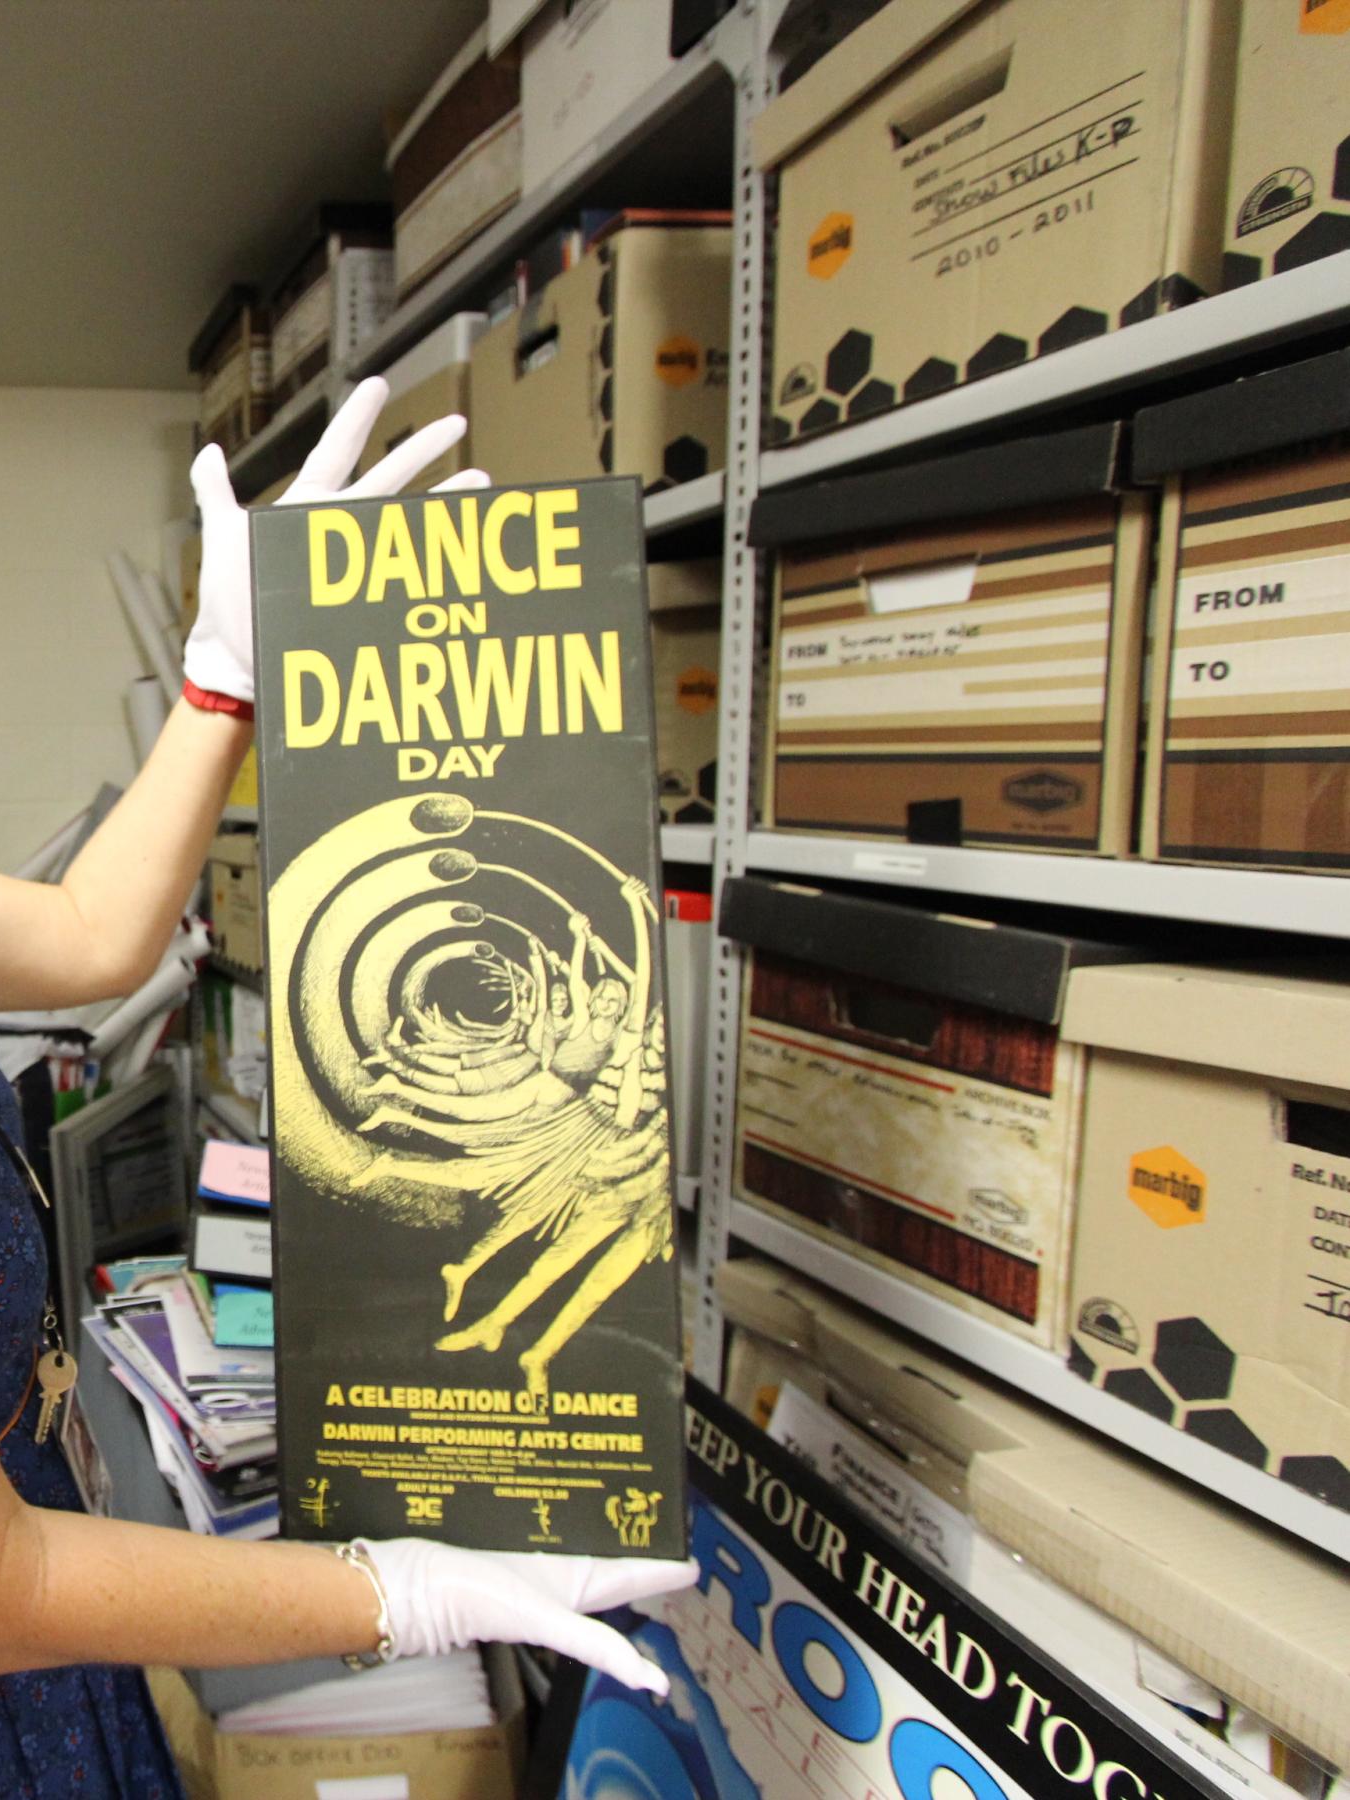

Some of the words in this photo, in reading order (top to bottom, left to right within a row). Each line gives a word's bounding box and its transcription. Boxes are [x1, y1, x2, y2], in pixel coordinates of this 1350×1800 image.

[936, 236, 1000, 278] 2010
[1032, 190, 1095, 232] 2011
[308, 488, 582, 606] DANCE
[1194, 581, 1286, 613] FROM
[405, 601, 486, 638] ON
[787, 643, 828, 660] FROM
[1190, 660, 1229, 684] TO
[283, 630, 623, 749] DARWIN
[786, 692, 806, 707] TO
[397, 744, 506, 782] DAY
[1132, 1166, 1204, 1213] marbig
[1291, 1162, 1327, 1186] Ref.
[325, 1384, 345, 1406] A
[348, 1385, 513, 1412] CELEBRATION
[553, 1392, 638, 1417] DANCE
[322, 1422, 396, 1442] DARWIN
[399, 1425, 516, 1448] PERFORMING
[518, 1430, 569, 1450] ARTS
[570, 1432, 643, 1453] CENTRE
[396, 1482, 426, 1493] ADULT
[493, 1486, 540, 1499] CHILDREN
[684, 1404, 742, 1478] EEP
[743, 1451, 846, 1584] YOUR
[854, 1551, 997, 1700] HEAD
